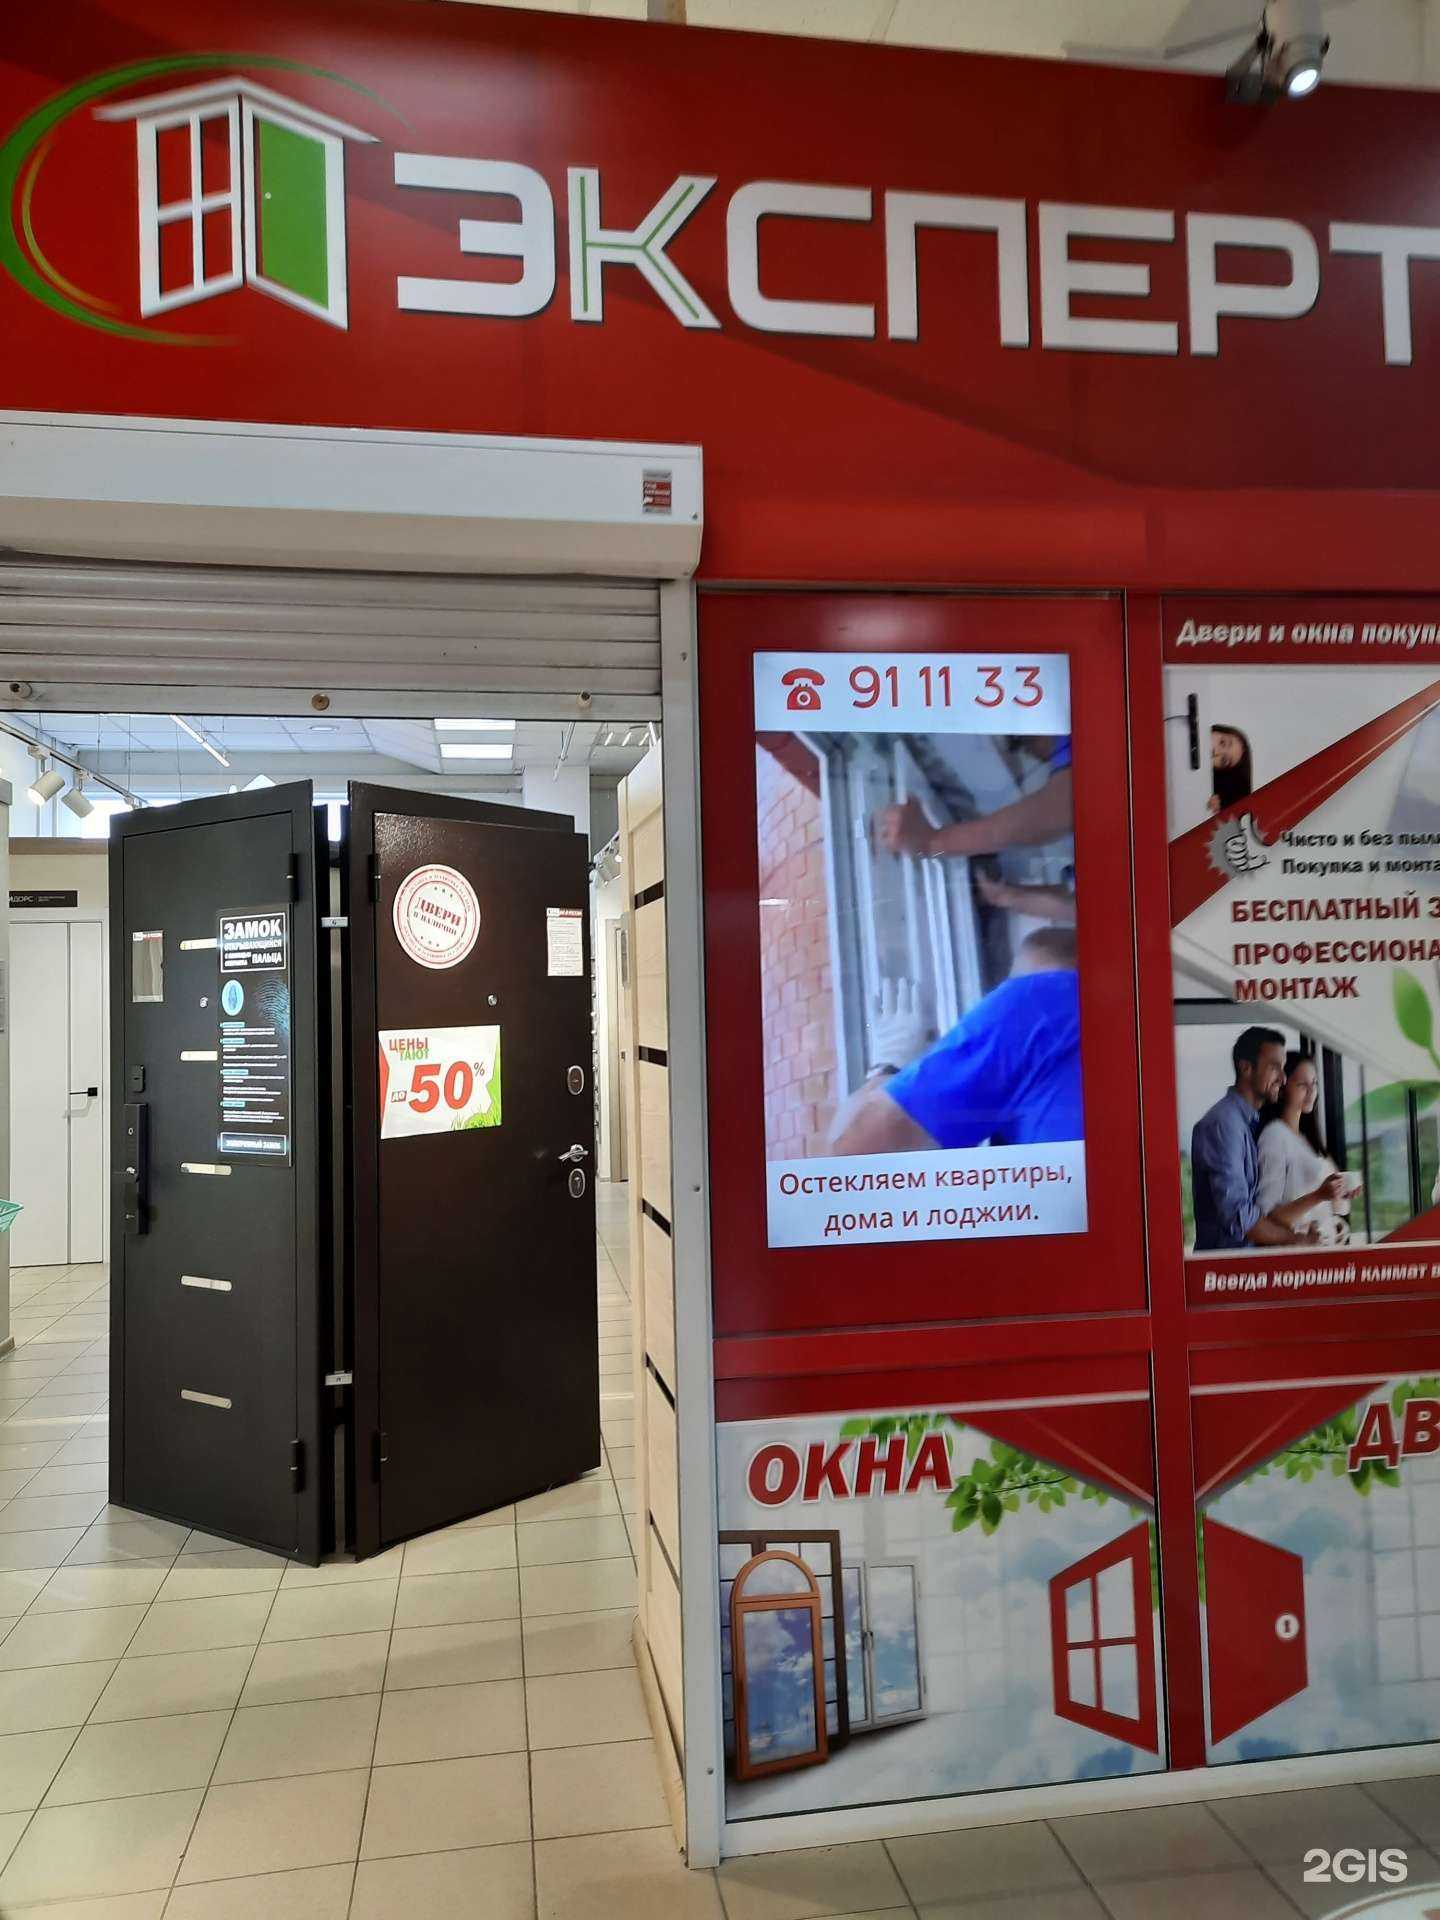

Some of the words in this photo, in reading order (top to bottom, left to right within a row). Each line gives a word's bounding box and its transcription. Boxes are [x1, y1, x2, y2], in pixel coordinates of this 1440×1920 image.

[394, 151, 1440, 369] ЭКСПЕРТ
[1176, 618, 1262, 647] Двери
[1268, 623, 1285, 643] и
[1291, 623, 1354, 644] окна
[849, 665, 899, 708] 91
[919, 666, 951, 707] 11
[975, 666, 1043, 708] 33
[1281, 832, 1338, 848] Чисто
[1343, 834, 1355, 847] и
[1360, 829, 1393, 846] без
[1282, 859, 1363, 877] Покупка
[1369, 861, 1380, 873] и
[413, 897, 462, 926] ДВЕРИ
[1232, 890, 1419, 922] БЕСПЛАТНЫЙ
[224, 919, 282, 940] ЗАМОК
[251, 952, 282, 964] ПАЛЬЦА
[1233, 938, 1440, 965] ПРОФЕССИОНА
[1234, 976, 1359, 1001] МОНТАЖ
[389, 1037, 428, 1053] ЦЕНЫ
[400, 1049, 430, 1061] ТАЮТ
[779, 1168, 927, 1195] Остекляем
[935, 1164, 1073, 1191] квартиры,
[824, 1209, 894, 1236] дома
[902, 1209, 919, 1227] и
[926, 1203, 1040, 1231] лоджии.
[1204, 1271, 1267, 1292] Всегда
[1272, 1262, 1356, 1291] хороший
[1361, 1263, 1428, 1283] климат
[747, 1431, 953, 1508] ОКНА
